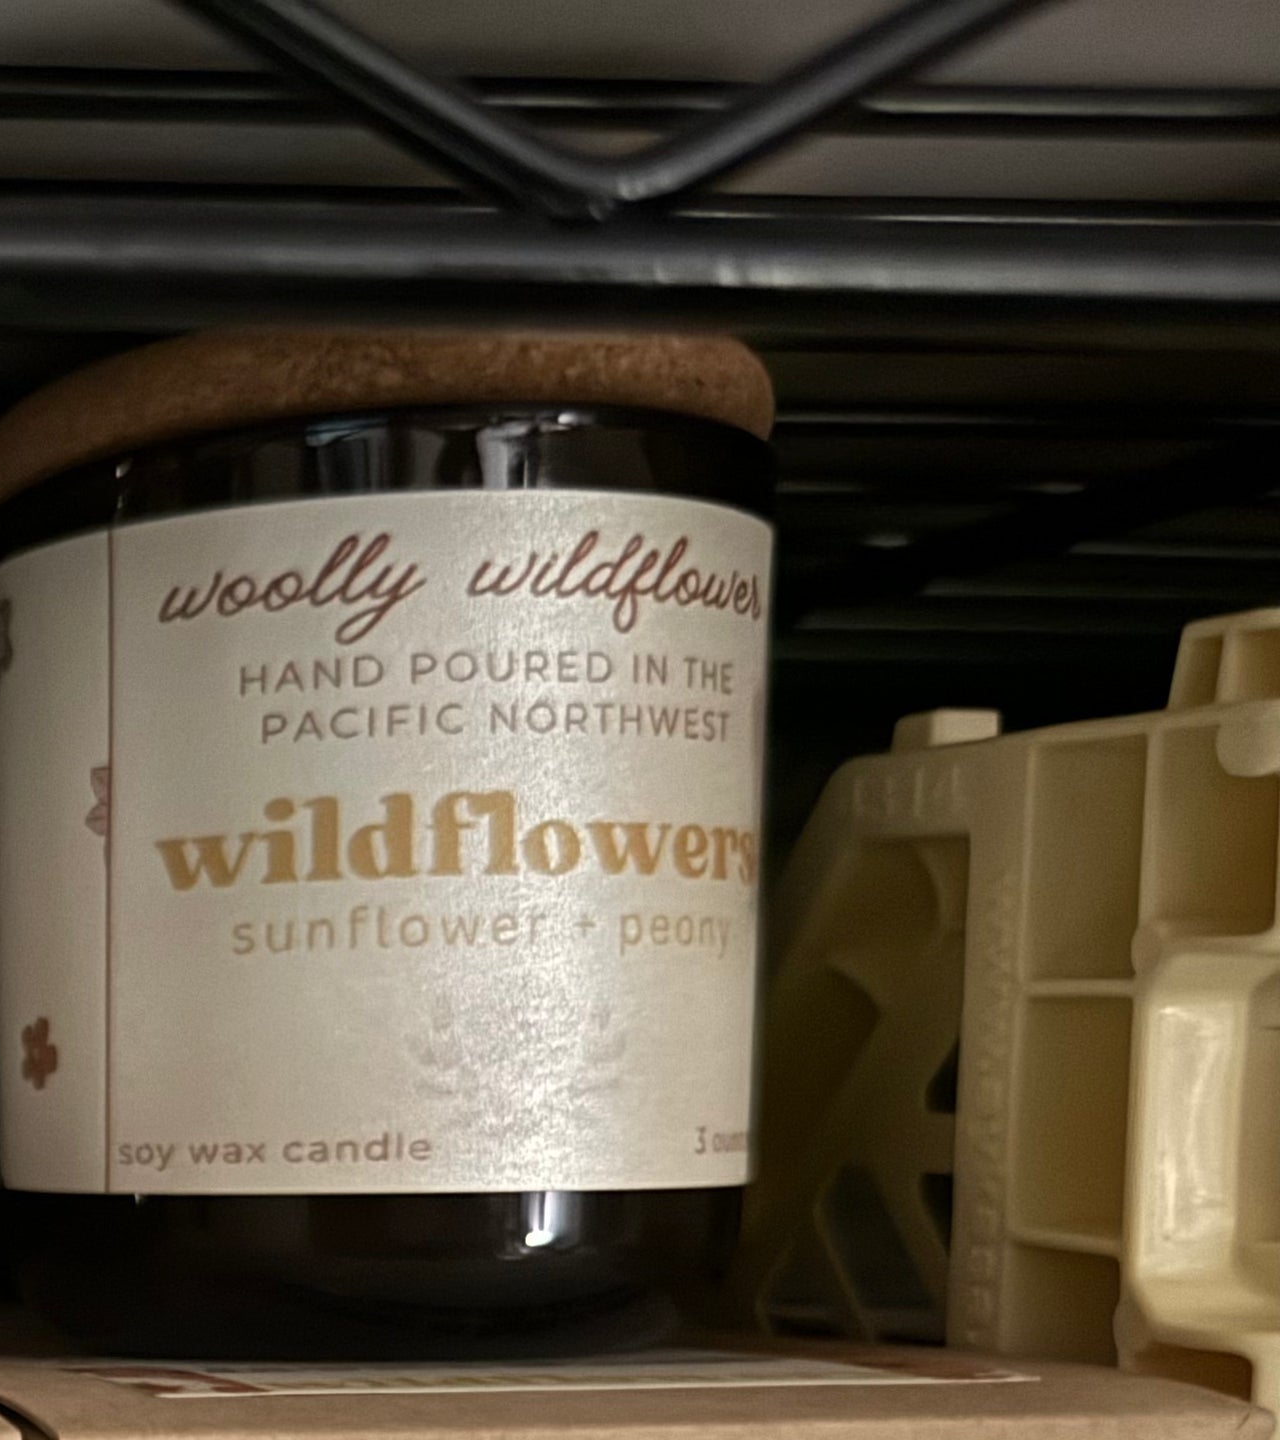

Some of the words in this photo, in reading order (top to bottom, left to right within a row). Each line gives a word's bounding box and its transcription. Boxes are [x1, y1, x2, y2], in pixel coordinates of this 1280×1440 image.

[156, 532, 427, 646] woolly
[467, 530, 763, 634] wildflower
[239, 654, 386, 698] HAND
[408, 649, 615, 688] POURED
[631, 652, 668, 686] IN
[683, 656, 735, 695] THE
[260, 702, 466, 745] PACIFIC
[489, 700, 732, 744] NORTHWEST
[153, 789, 757, 893] wildflowers
[231, 905, 550, 956] sunflower
[573, 913, 597, 942] +
[619, 910, 734, 960] peony
[118, 1141, 175, 1175] soy
[188, 1139, 266, 1165] wax
[282, 1132, 432, 1165] candle
